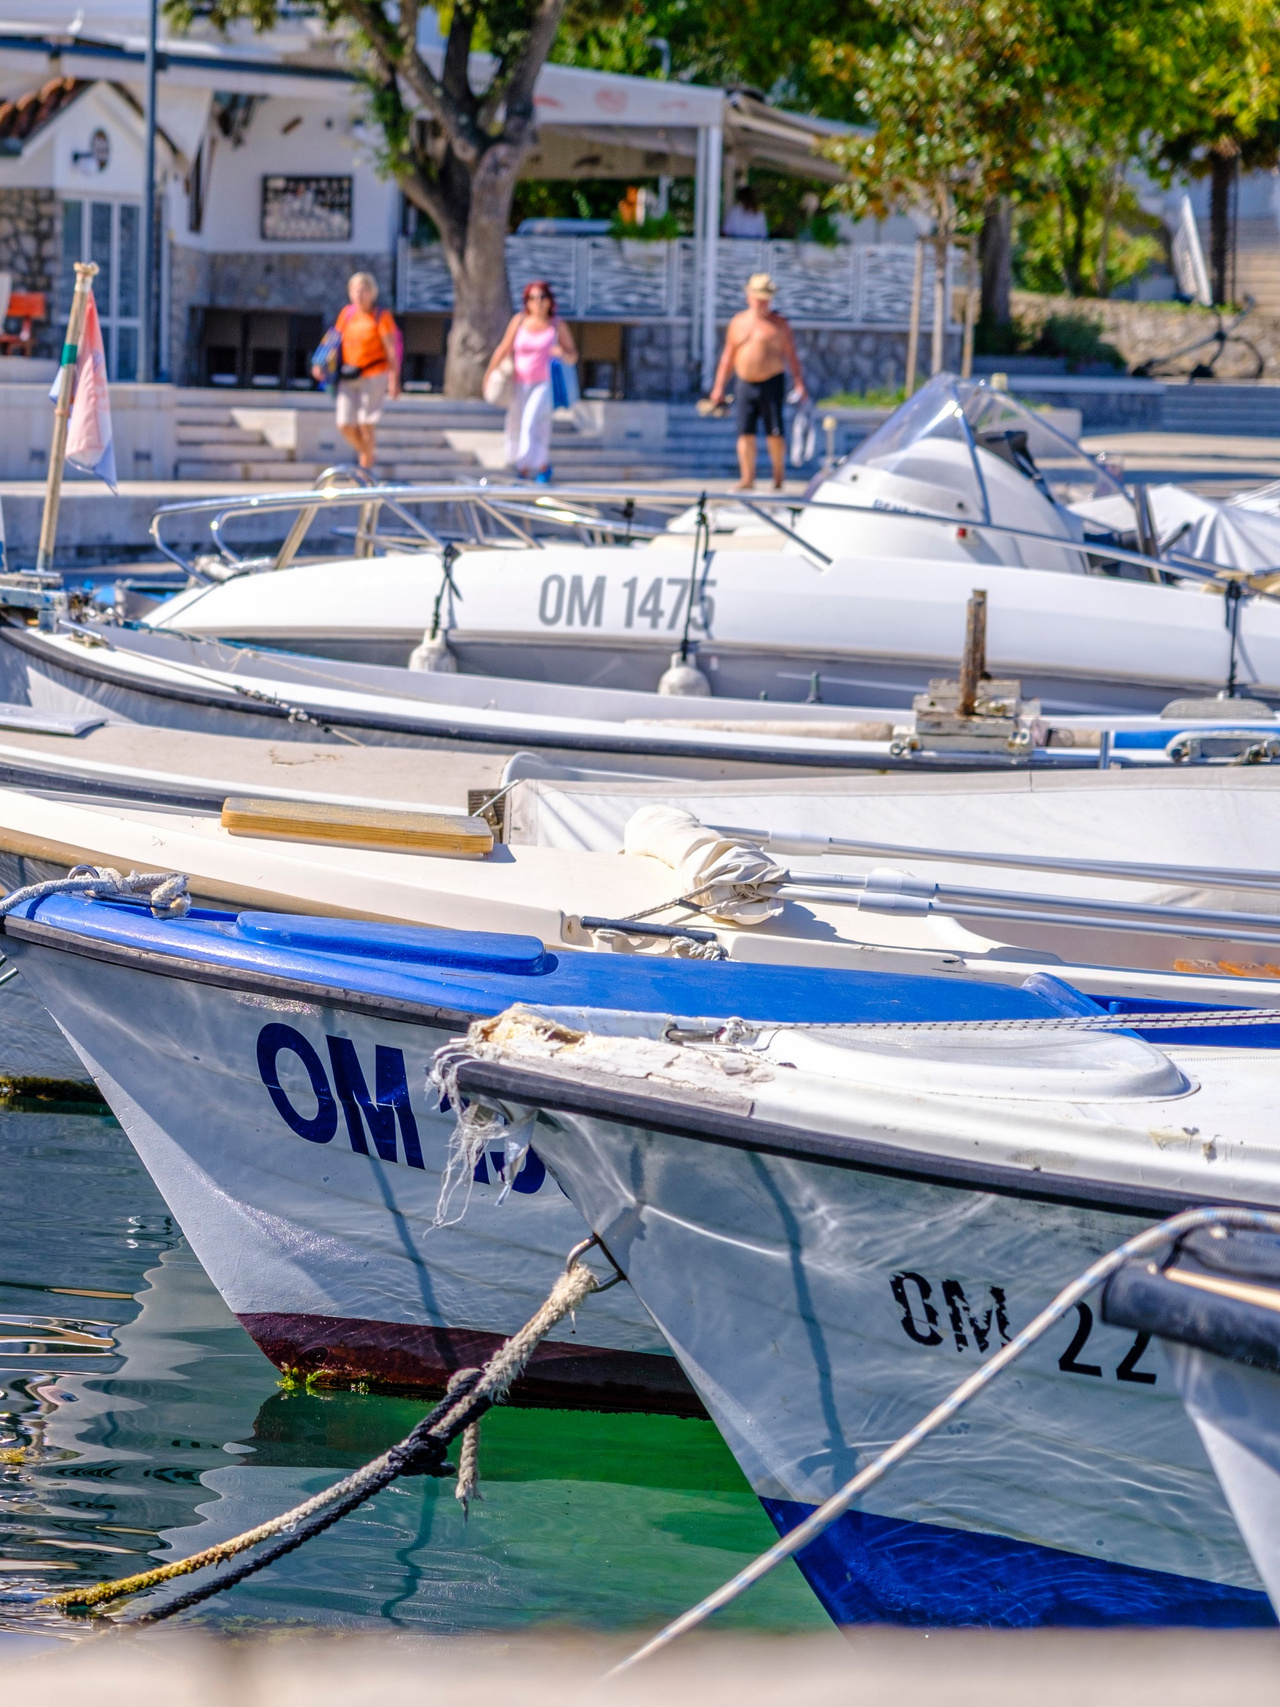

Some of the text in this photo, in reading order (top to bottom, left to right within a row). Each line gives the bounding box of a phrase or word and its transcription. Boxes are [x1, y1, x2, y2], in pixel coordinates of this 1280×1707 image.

[538, 574, 718, 632] OM 1475
[256, 1022, 426, 1170] OM
[889, 1271, 1014, 1353] OM
